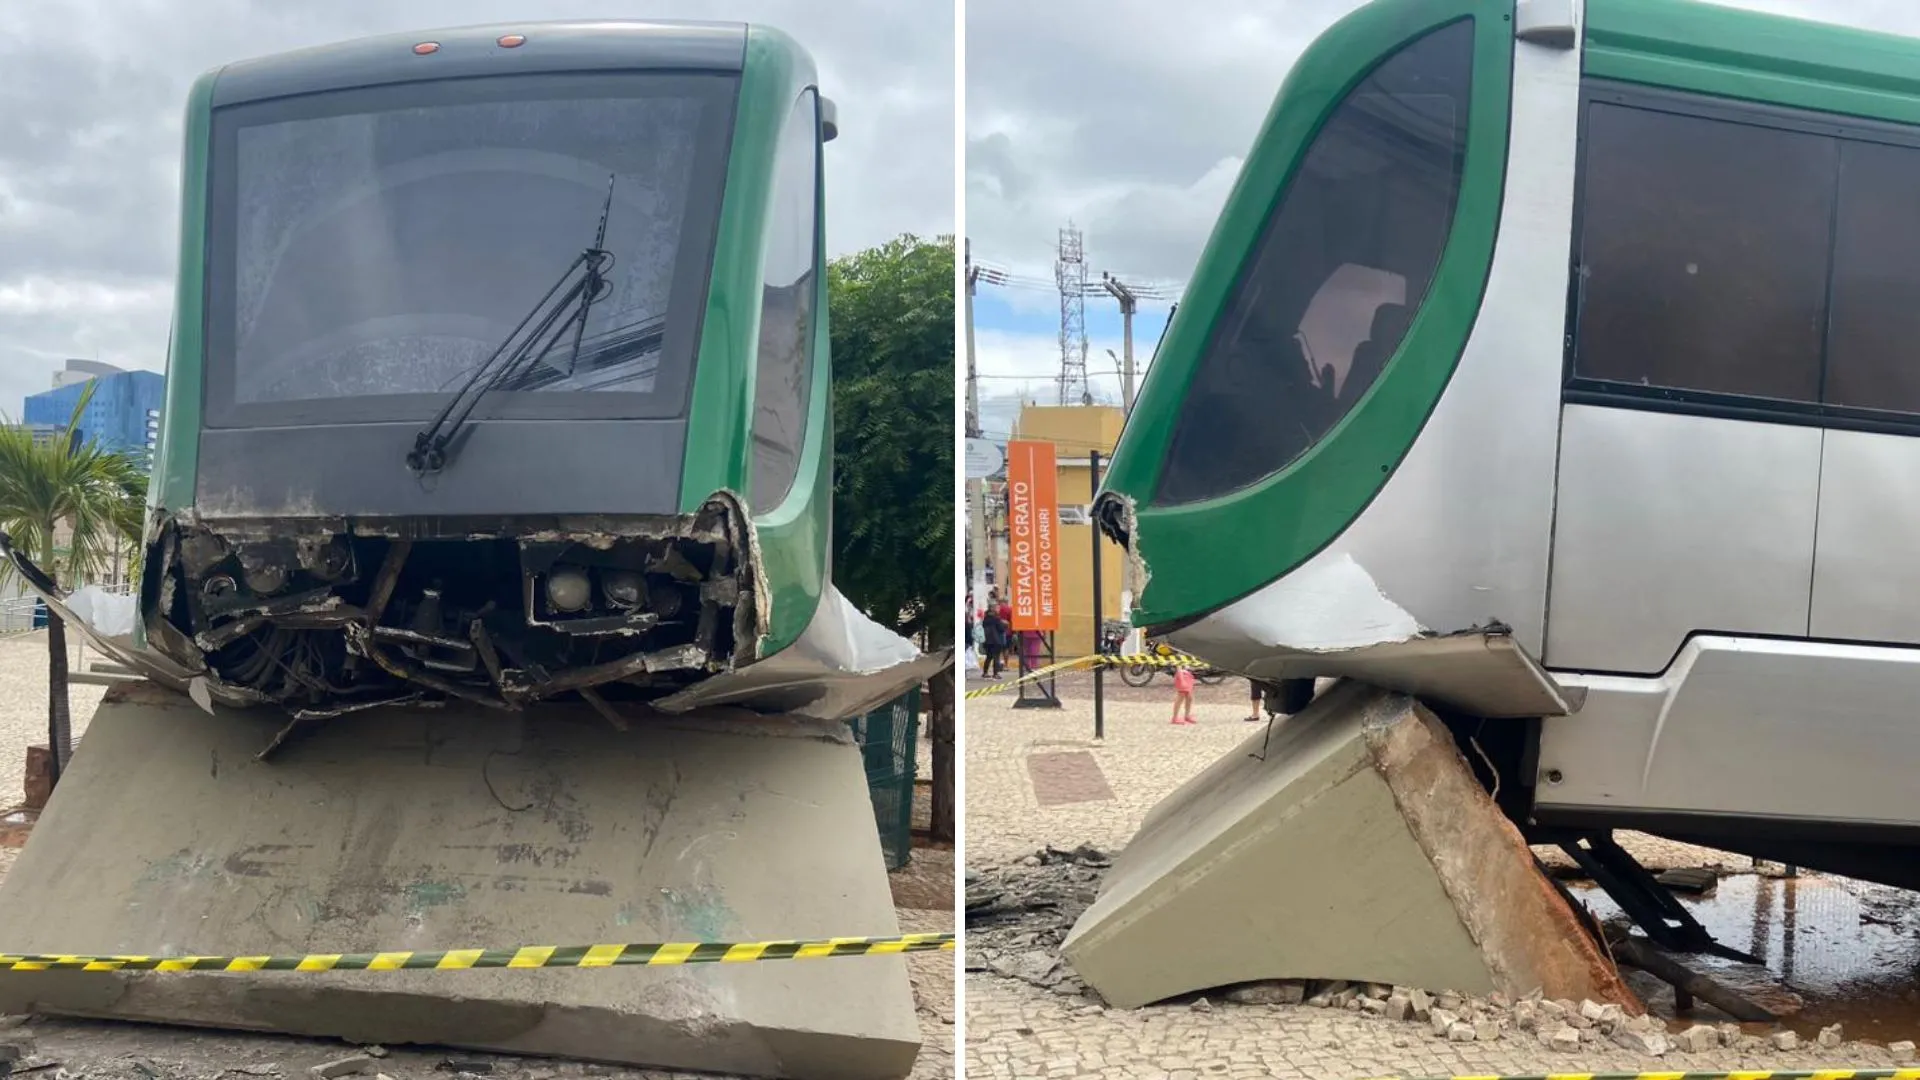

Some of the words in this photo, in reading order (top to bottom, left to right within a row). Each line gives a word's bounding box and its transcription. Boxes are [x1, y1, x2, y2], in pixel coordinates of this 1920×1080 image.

[1014, 482, 1029, 536] CRATO
[1038, 508, 1051, 549] CARIRI
[1013, 541, 1034, 616] ESTAÇÃO
[1040, 552, 1051, 571] DO
[1039, 573, 1053, 616] METRÔ
